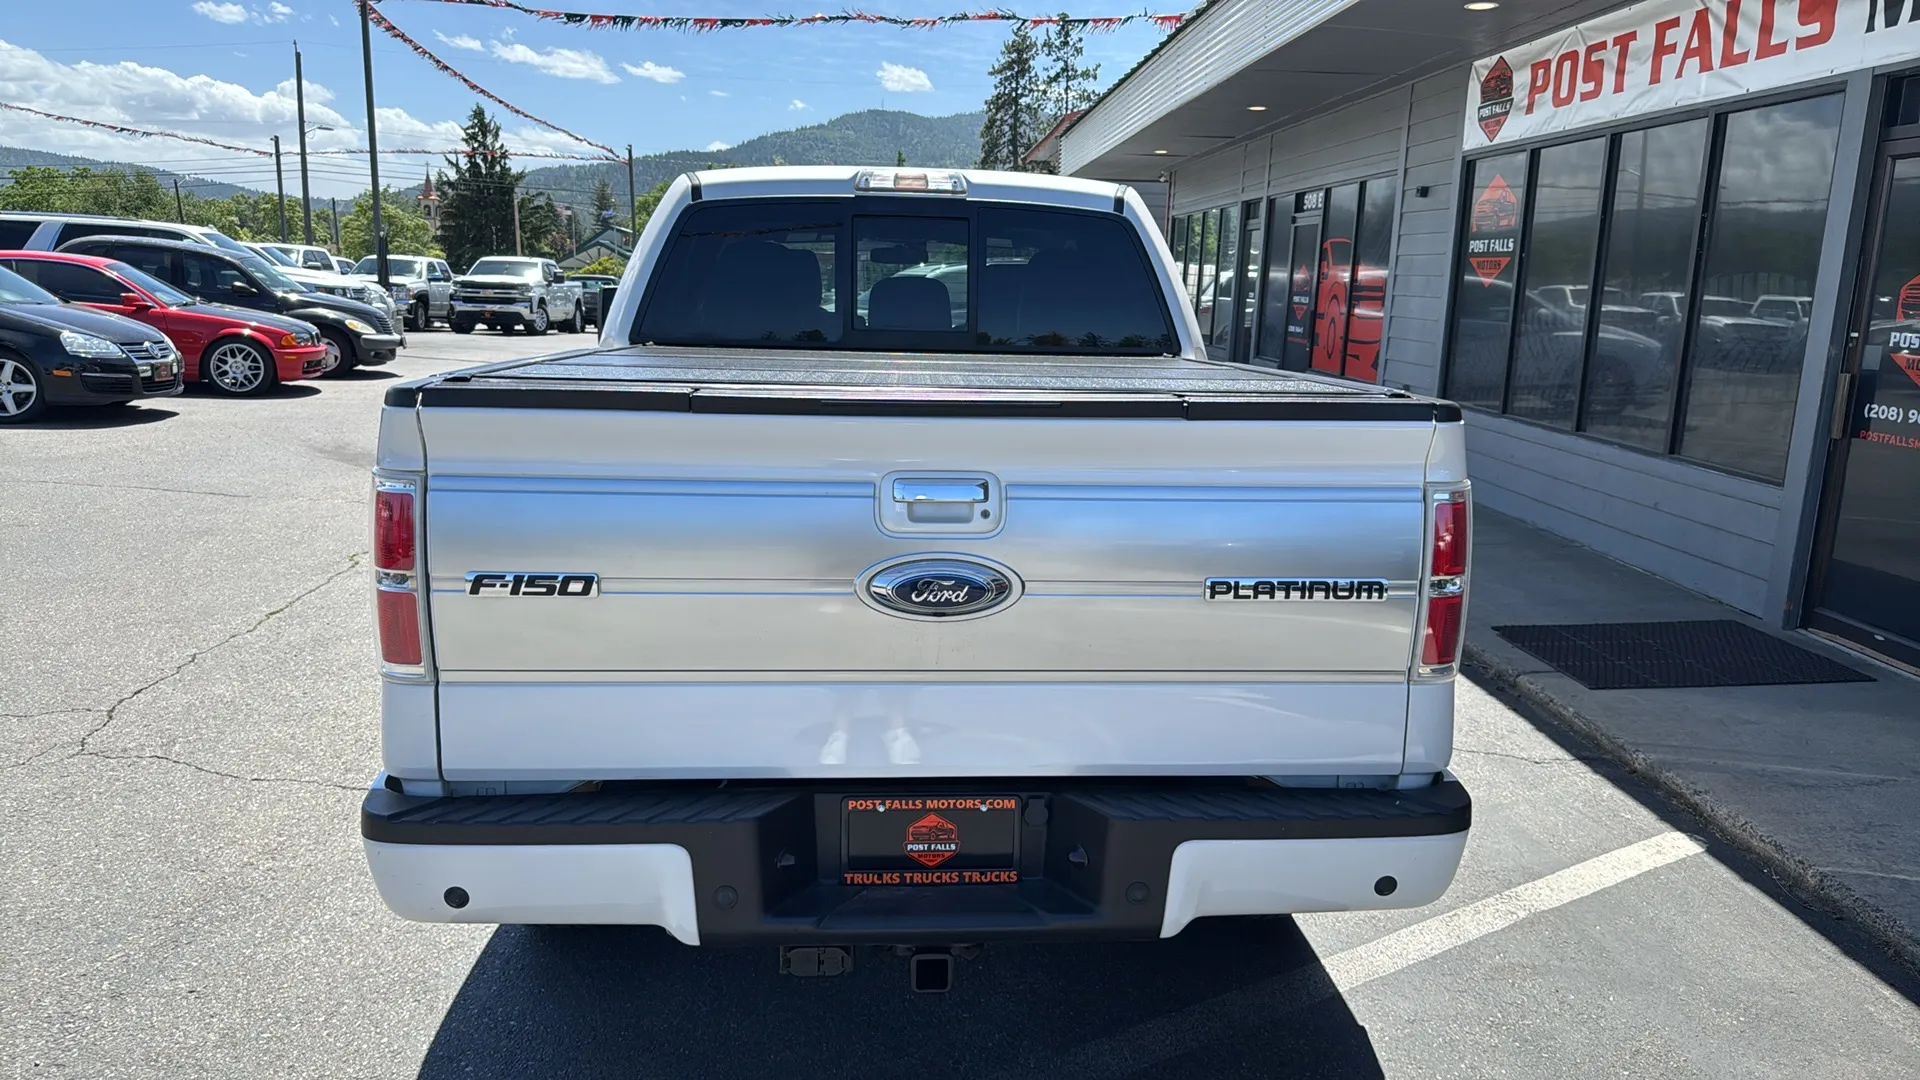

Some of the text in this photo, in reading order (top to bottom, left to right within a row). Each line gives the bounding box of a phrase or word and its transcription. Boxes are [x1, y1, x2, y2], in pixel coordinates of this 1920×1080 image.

[1525, 0, 1839, 115] POST FALLS
[1492, 101, 1512, 114] FALLS
[1468, 238, 1515, 253] POST FALLS
[1888, 332, 1920, 349] POS
[1864, 404, 1920, 425] (208) 9
[468, 574, 596, 597] F-150
[911, 578, 970, 602] Ford
[1209, 580, 1385, 600] PLATINUM
[848, 799, 1016, 810] POST FALLS MOTORSCOM
[907, 843, 929, 851] POST
[904, 871, 960, 884] TRUCKS
